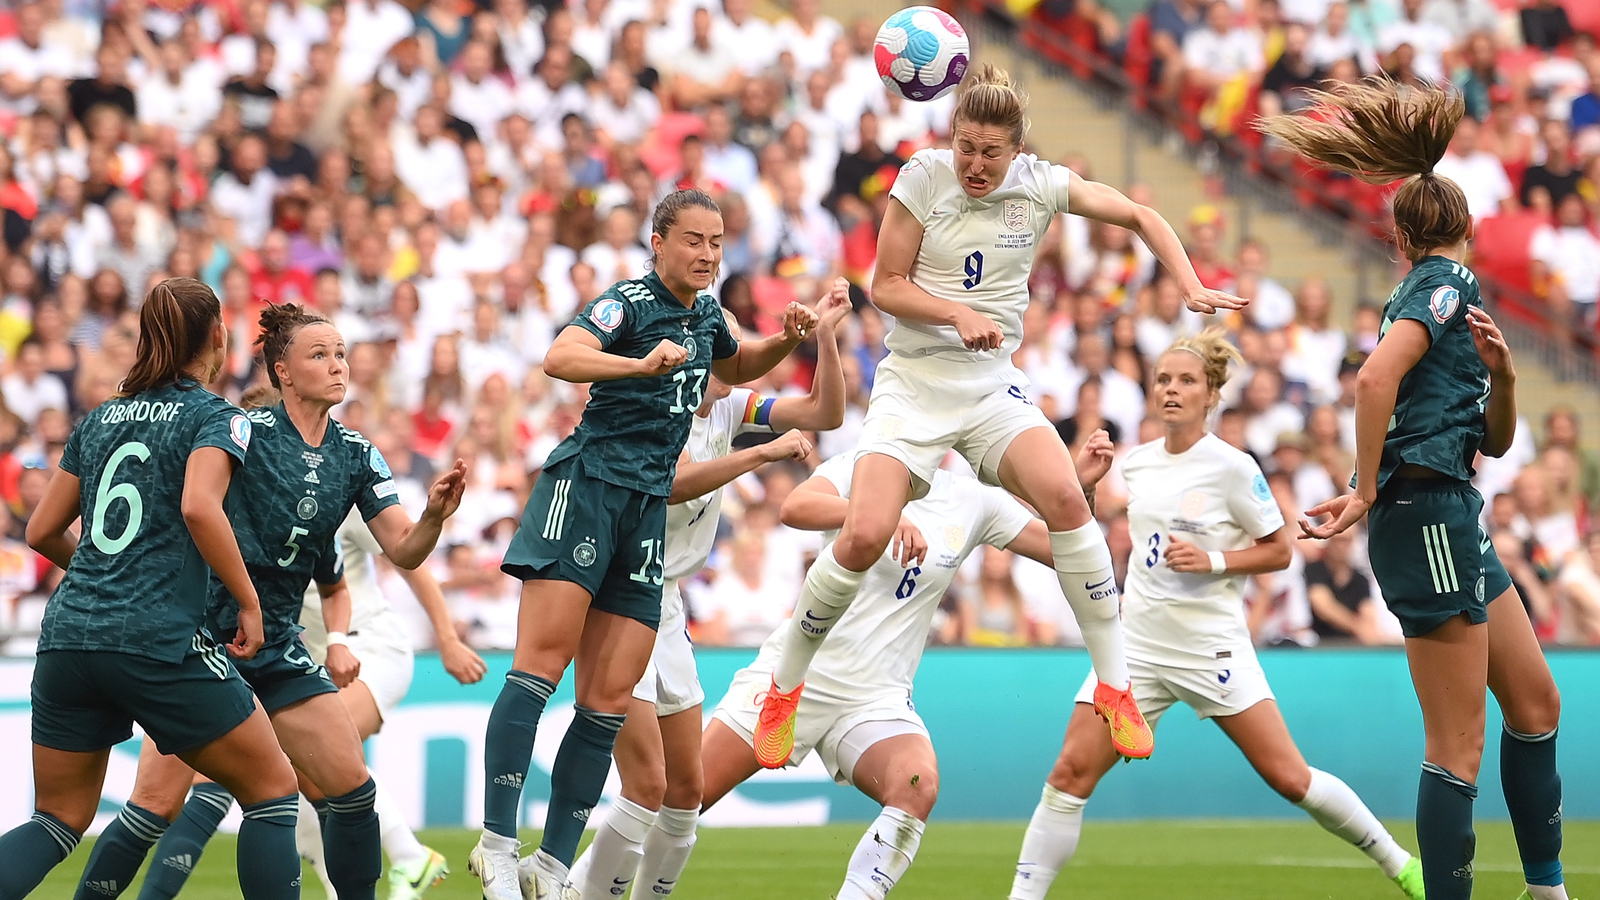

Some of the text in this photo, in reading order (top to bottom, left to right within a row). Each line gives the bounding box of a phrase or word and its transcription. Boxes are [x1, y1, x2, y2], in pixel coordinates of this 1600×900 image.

[962, 250, 983, 290] 9
[669, 368, 707, 414] 13
[91, 441, 151, 555] 6
[277, 526, 309, 567] 5
[1146, 532, 1160, 569] 3
[895, 566, 921, 600] 6
[283, 644, 319, 675] 5
